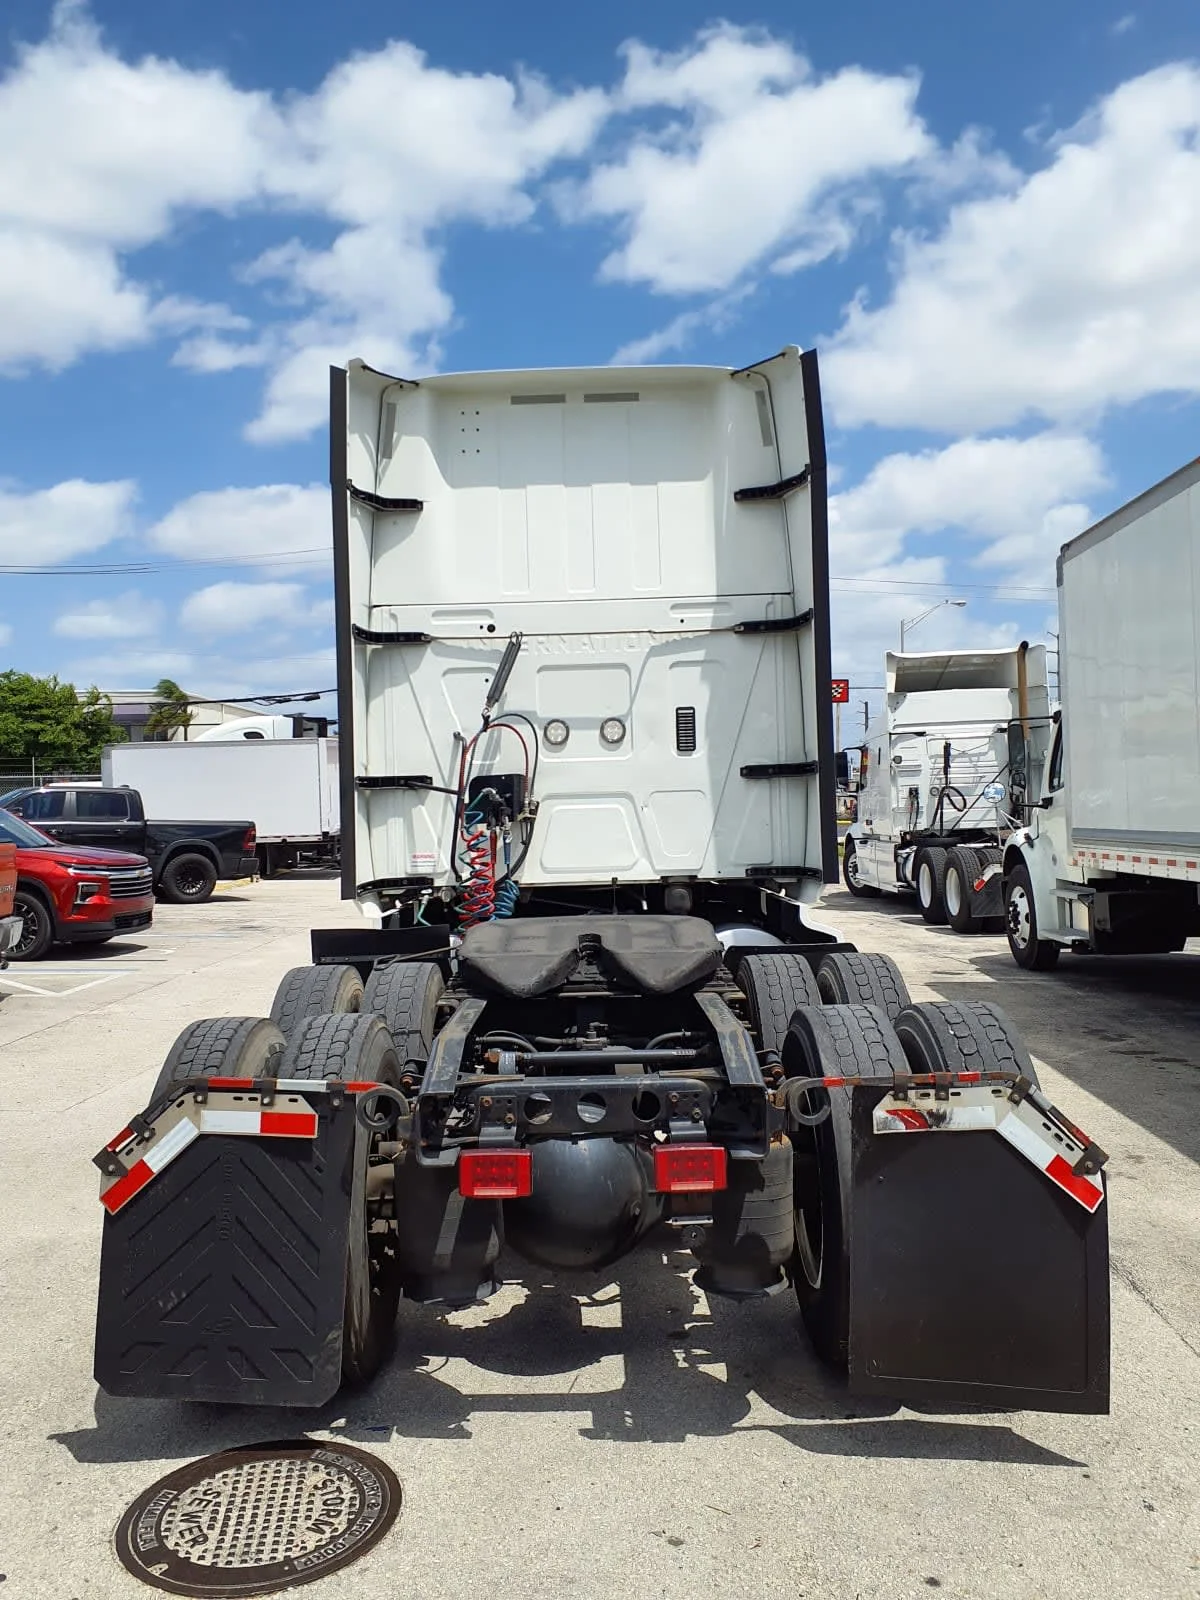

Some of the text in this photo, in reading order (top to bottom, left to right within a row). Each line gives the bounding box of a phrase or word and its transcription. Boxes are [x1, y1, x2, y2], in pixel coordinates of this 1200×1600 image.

[142, 1490, 177, 1521] MIAMI
[178, 1487, 222, 1550] SEWER
[305, 1478, 346, 1536] STORM
